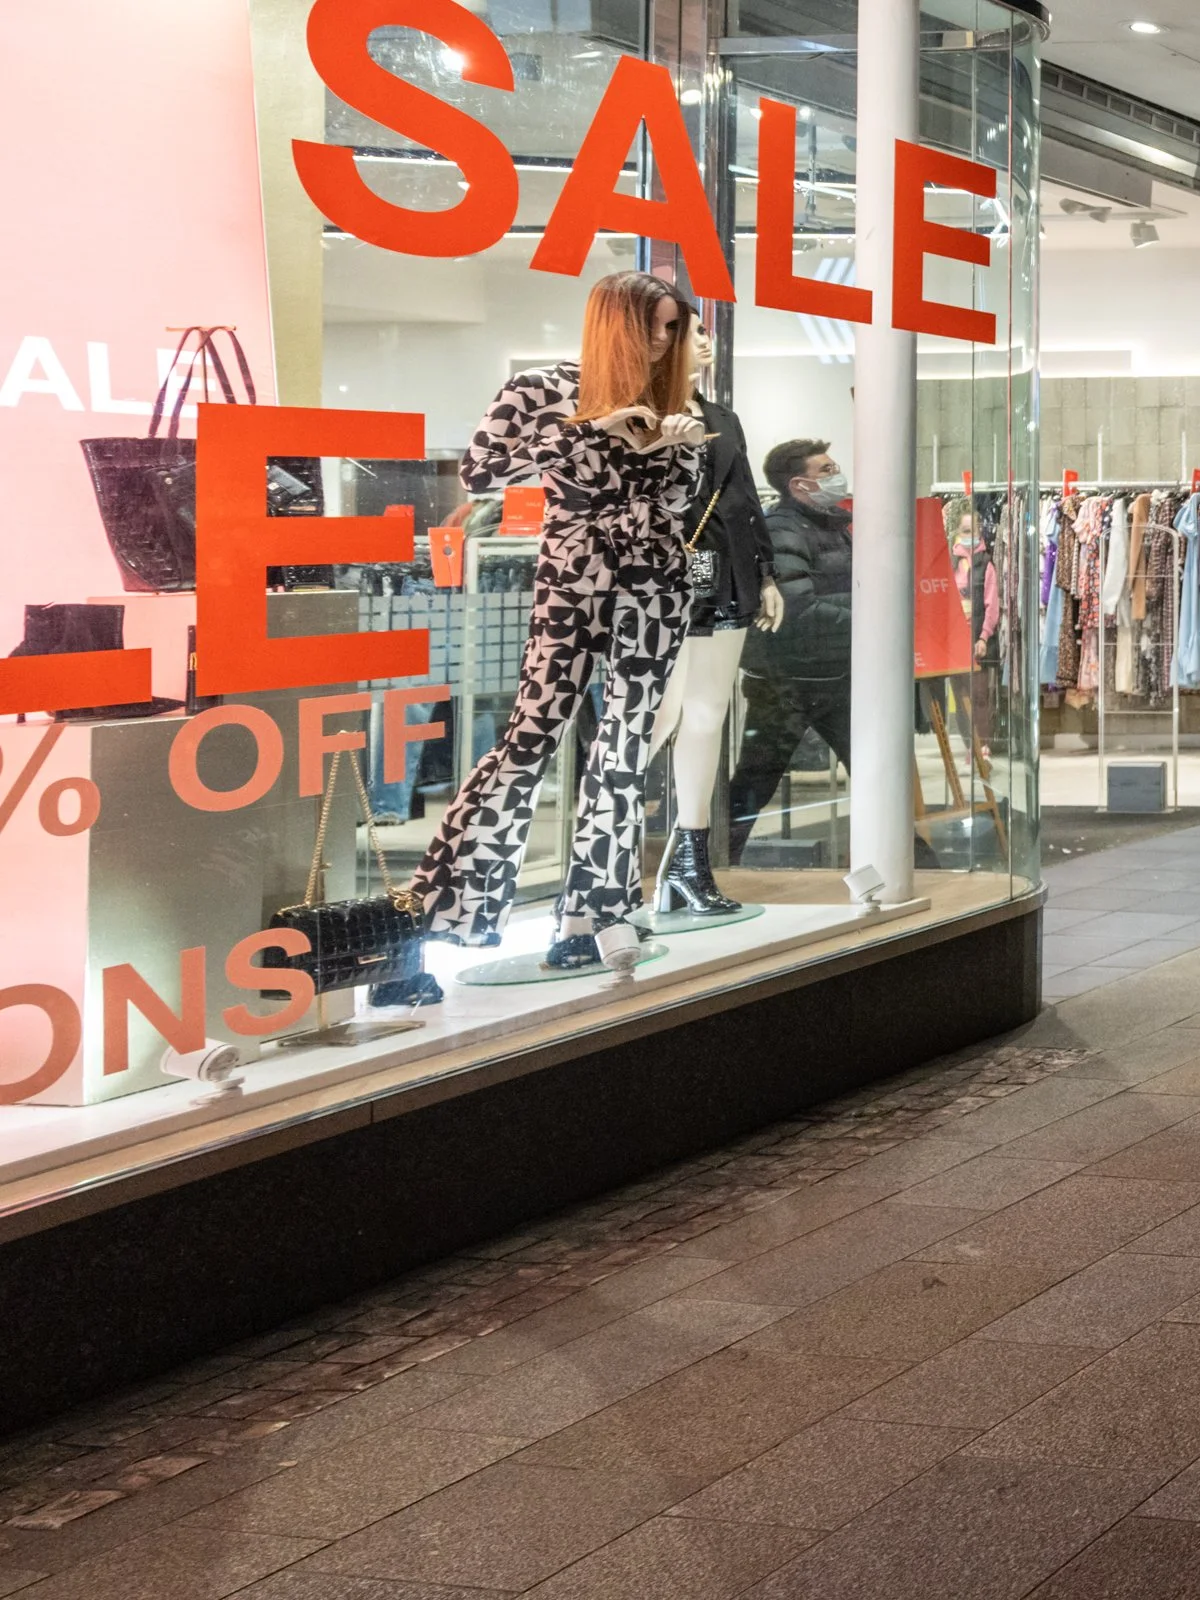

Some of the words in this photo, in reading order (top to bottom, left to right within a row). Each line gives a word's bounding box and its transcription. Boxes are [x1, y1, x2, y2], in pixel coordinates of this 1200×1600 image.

[292, 0, 996, 344] SALE
[919, 578, 949, 594] OFF
[168, 685, 450, 812] OFF
[0, 928, 315, 1104] ONS
